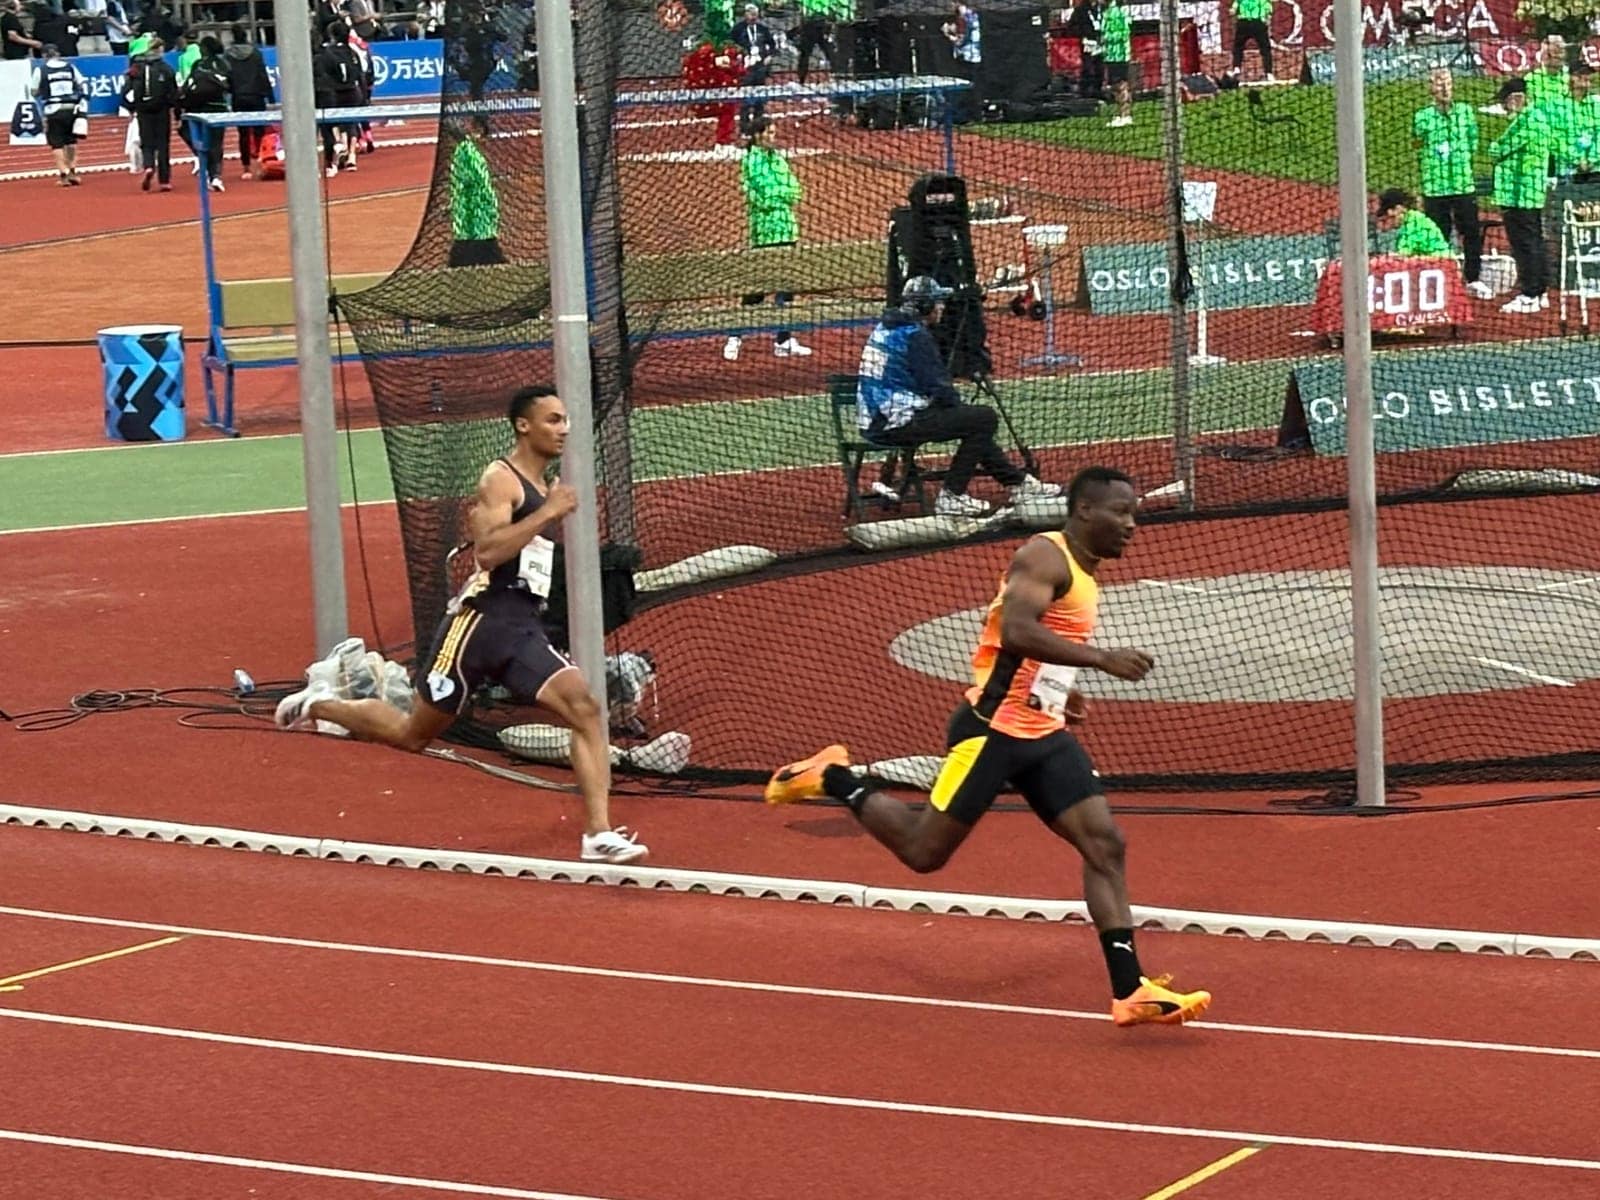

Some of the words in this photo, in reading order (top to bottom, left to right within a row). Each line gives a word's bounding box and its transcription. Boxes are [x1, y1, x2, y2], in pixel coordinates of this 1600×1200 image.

[21, 104, 34, 122] 5
[1091, 266, 1170, 291] OSLO
[1310, 391, 1410, 424] OO
